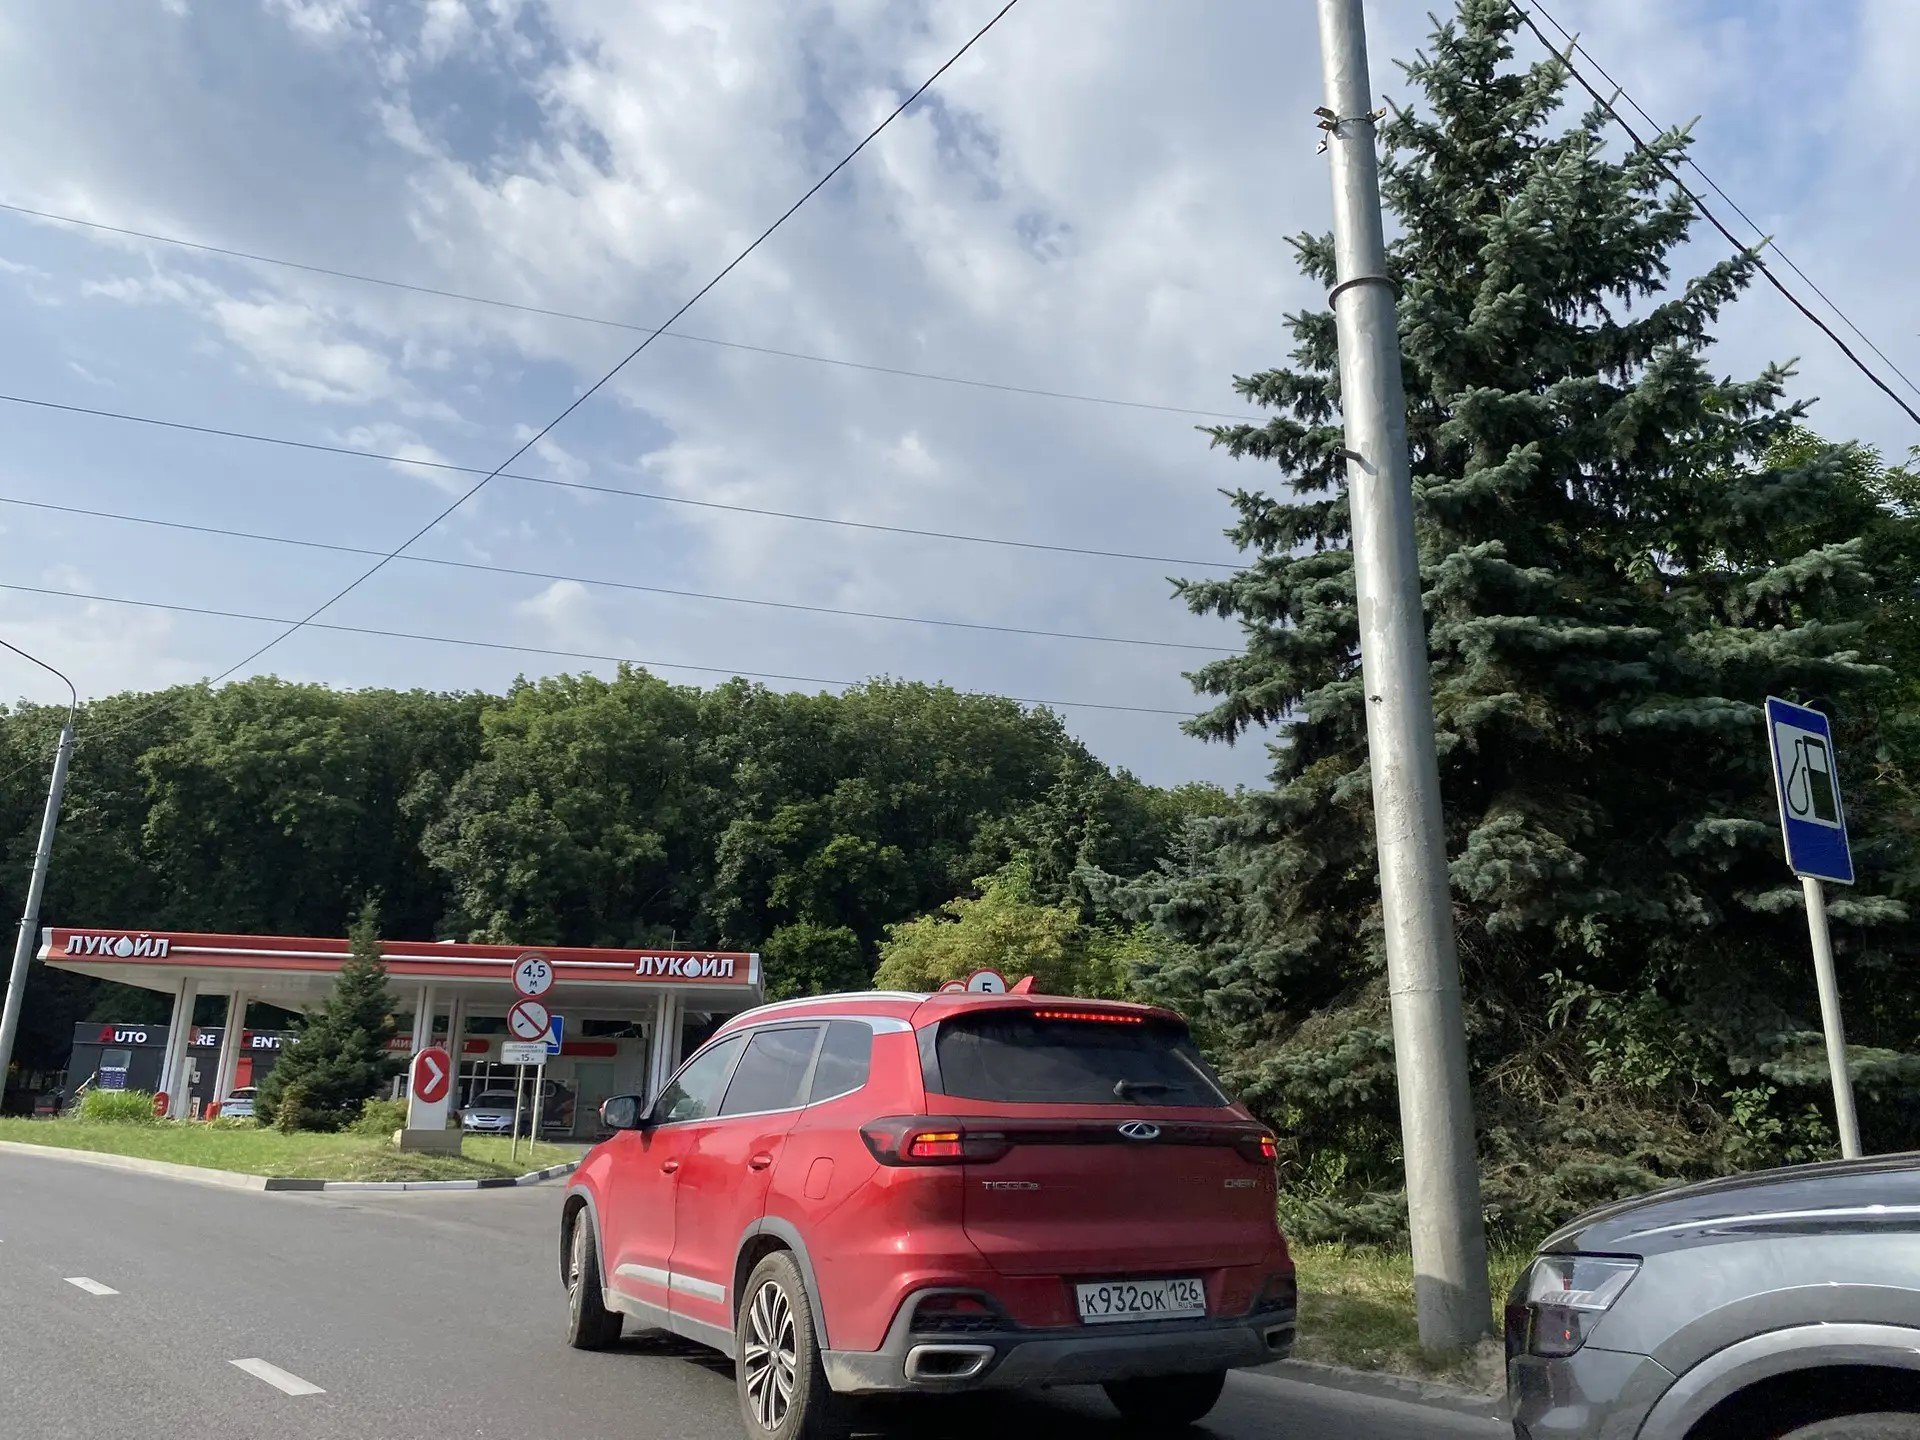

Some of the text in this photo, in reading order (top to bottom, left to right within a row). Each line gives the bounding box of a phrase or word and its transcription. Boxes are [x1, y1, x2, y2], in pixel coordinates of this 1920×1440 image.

[64, 934, 169, 957] ЛУКОЙЛ
[636, 954, 733, 977] ЛУКОЙЛ
[97, 1025, 147, 1043] AUTO
[1085, 1281, 1199, 1314] К932ОК 126
